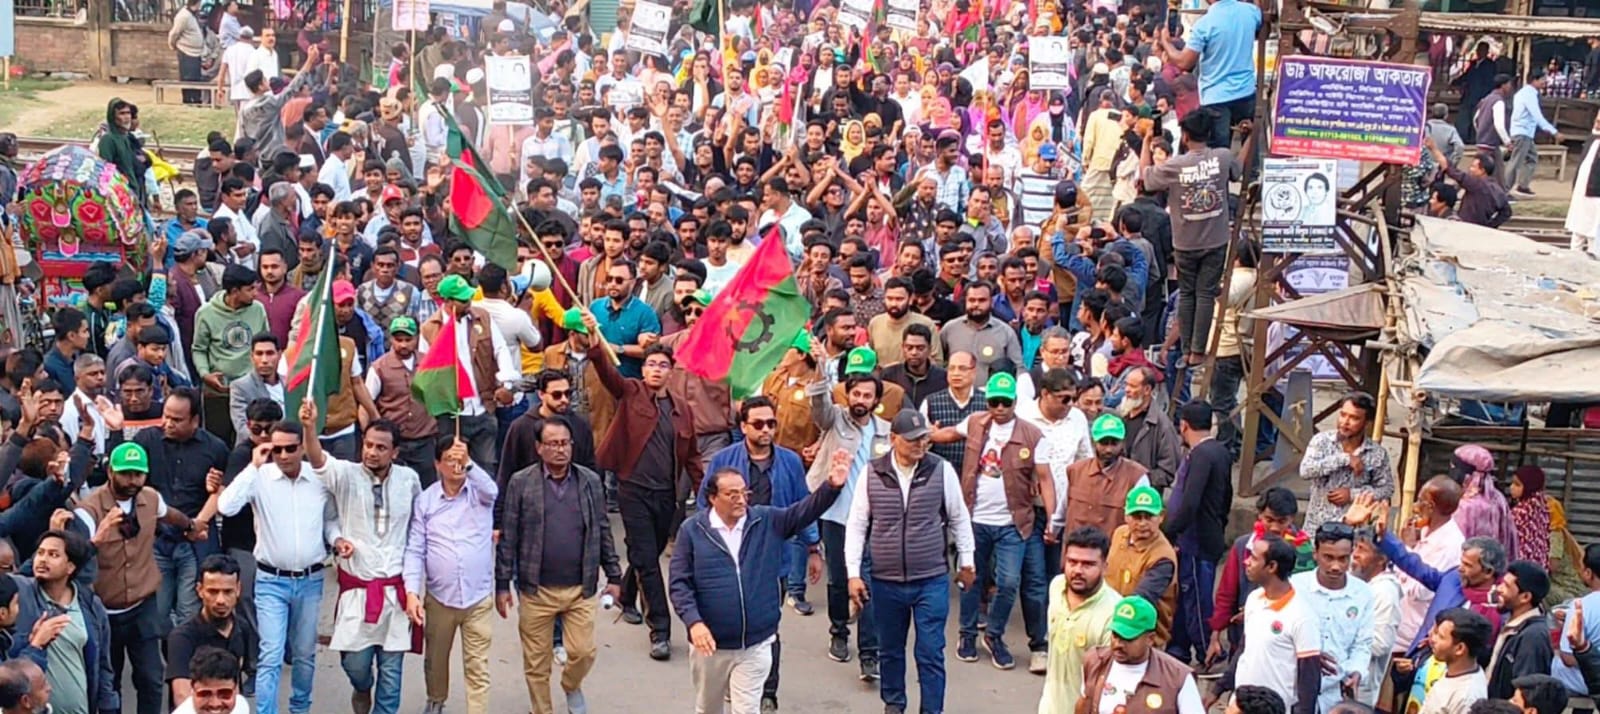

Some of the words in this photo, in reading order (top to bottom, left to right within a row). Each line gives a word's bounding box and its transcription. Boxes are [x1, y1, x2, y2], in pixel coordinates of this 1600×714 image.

[1285, 62, 1305, 79] ডাঃ
[1309, 63, 1370, 83] আফরোজা
[1373, 67, 1426, 88] আকতার
[1179, 168, 1211, 184] TRAIL
